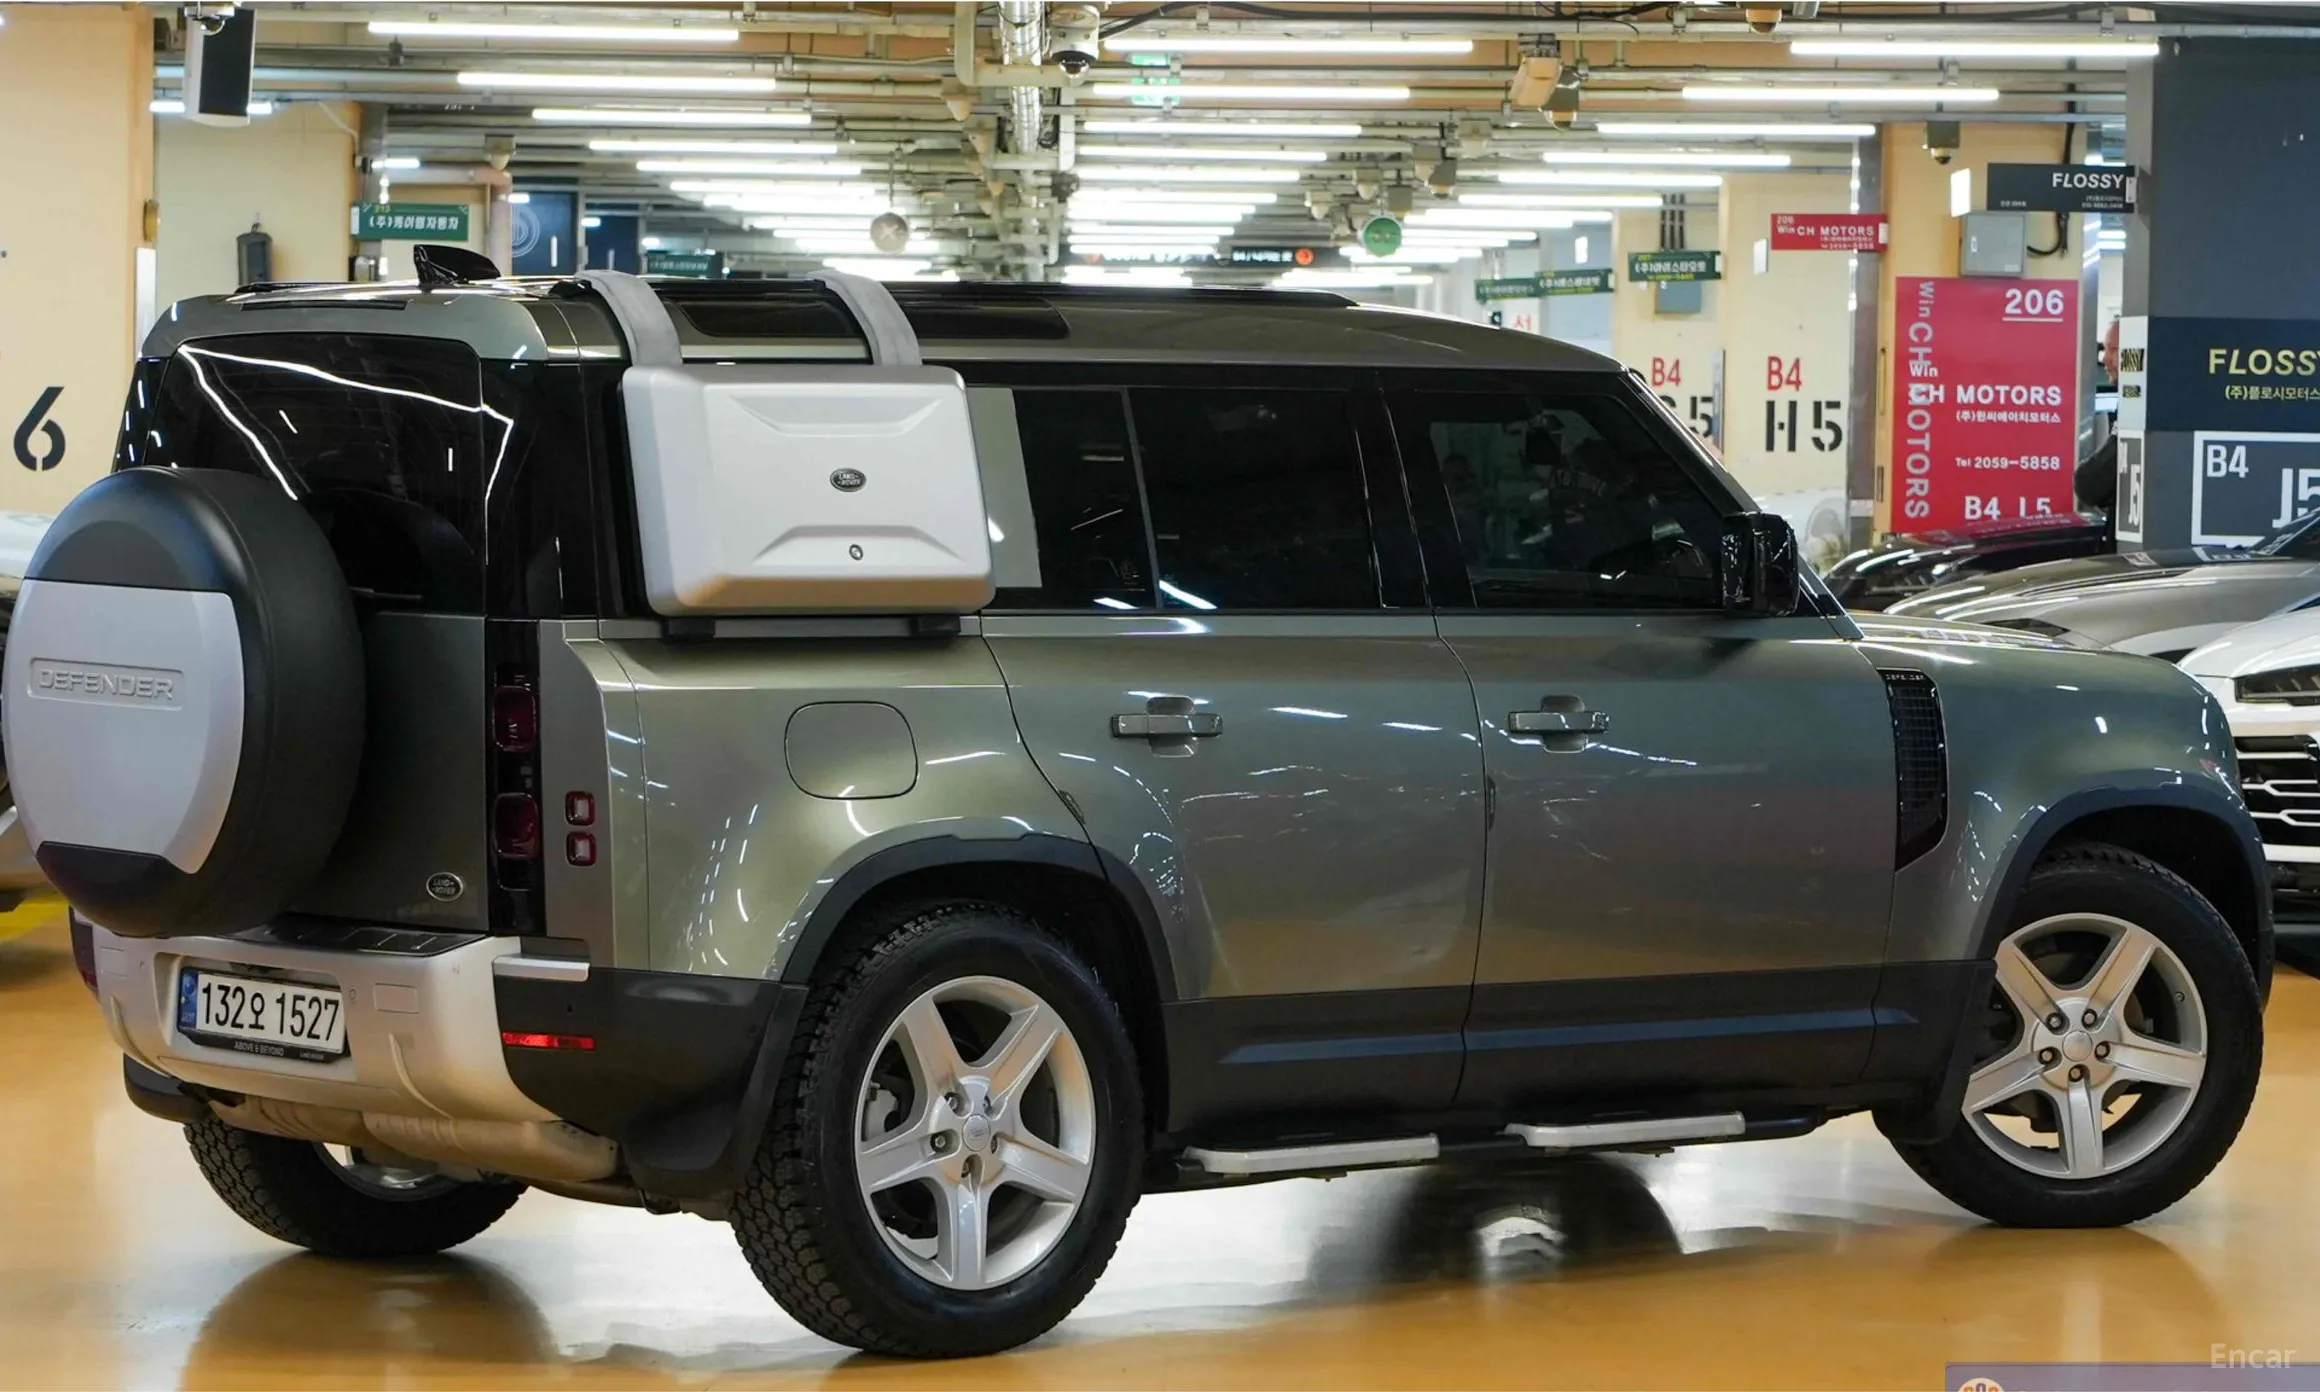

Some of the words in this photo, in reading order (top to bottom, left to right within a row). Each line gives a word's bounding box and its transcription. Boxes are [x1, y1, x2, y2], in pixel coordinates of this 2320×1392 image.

[2052, 172, 2124, 189] FLOSSY
[1797, 226, 1815, 236] CH
[1820, 226, 1874, 237] MOTORS
[1919, 281, 1934, 318] Win
[2005, 288, 2064, 315] 206
[1652, 357, 1682, 387] B4
[1767, 356, 1803, 391] B4
[1909, 360, 1938, 378] Win
[2208, 348, 2320, 376] FLOSS
[1956, 384, 2062, 406] MOTORS
[13, 386, 66, 472] 6
[1955, 457, 1972, 467] Tel
[1974, 456, 2061, 471] 2059-5858
[2206, 444, 2249, 479] B4
[1964, 495, 2001, 521] B4
[39, 668, 173, 701] DEFENDER
[202, 982, 265, 1030] 132오
[276, 992, 340, 1041] 1527
